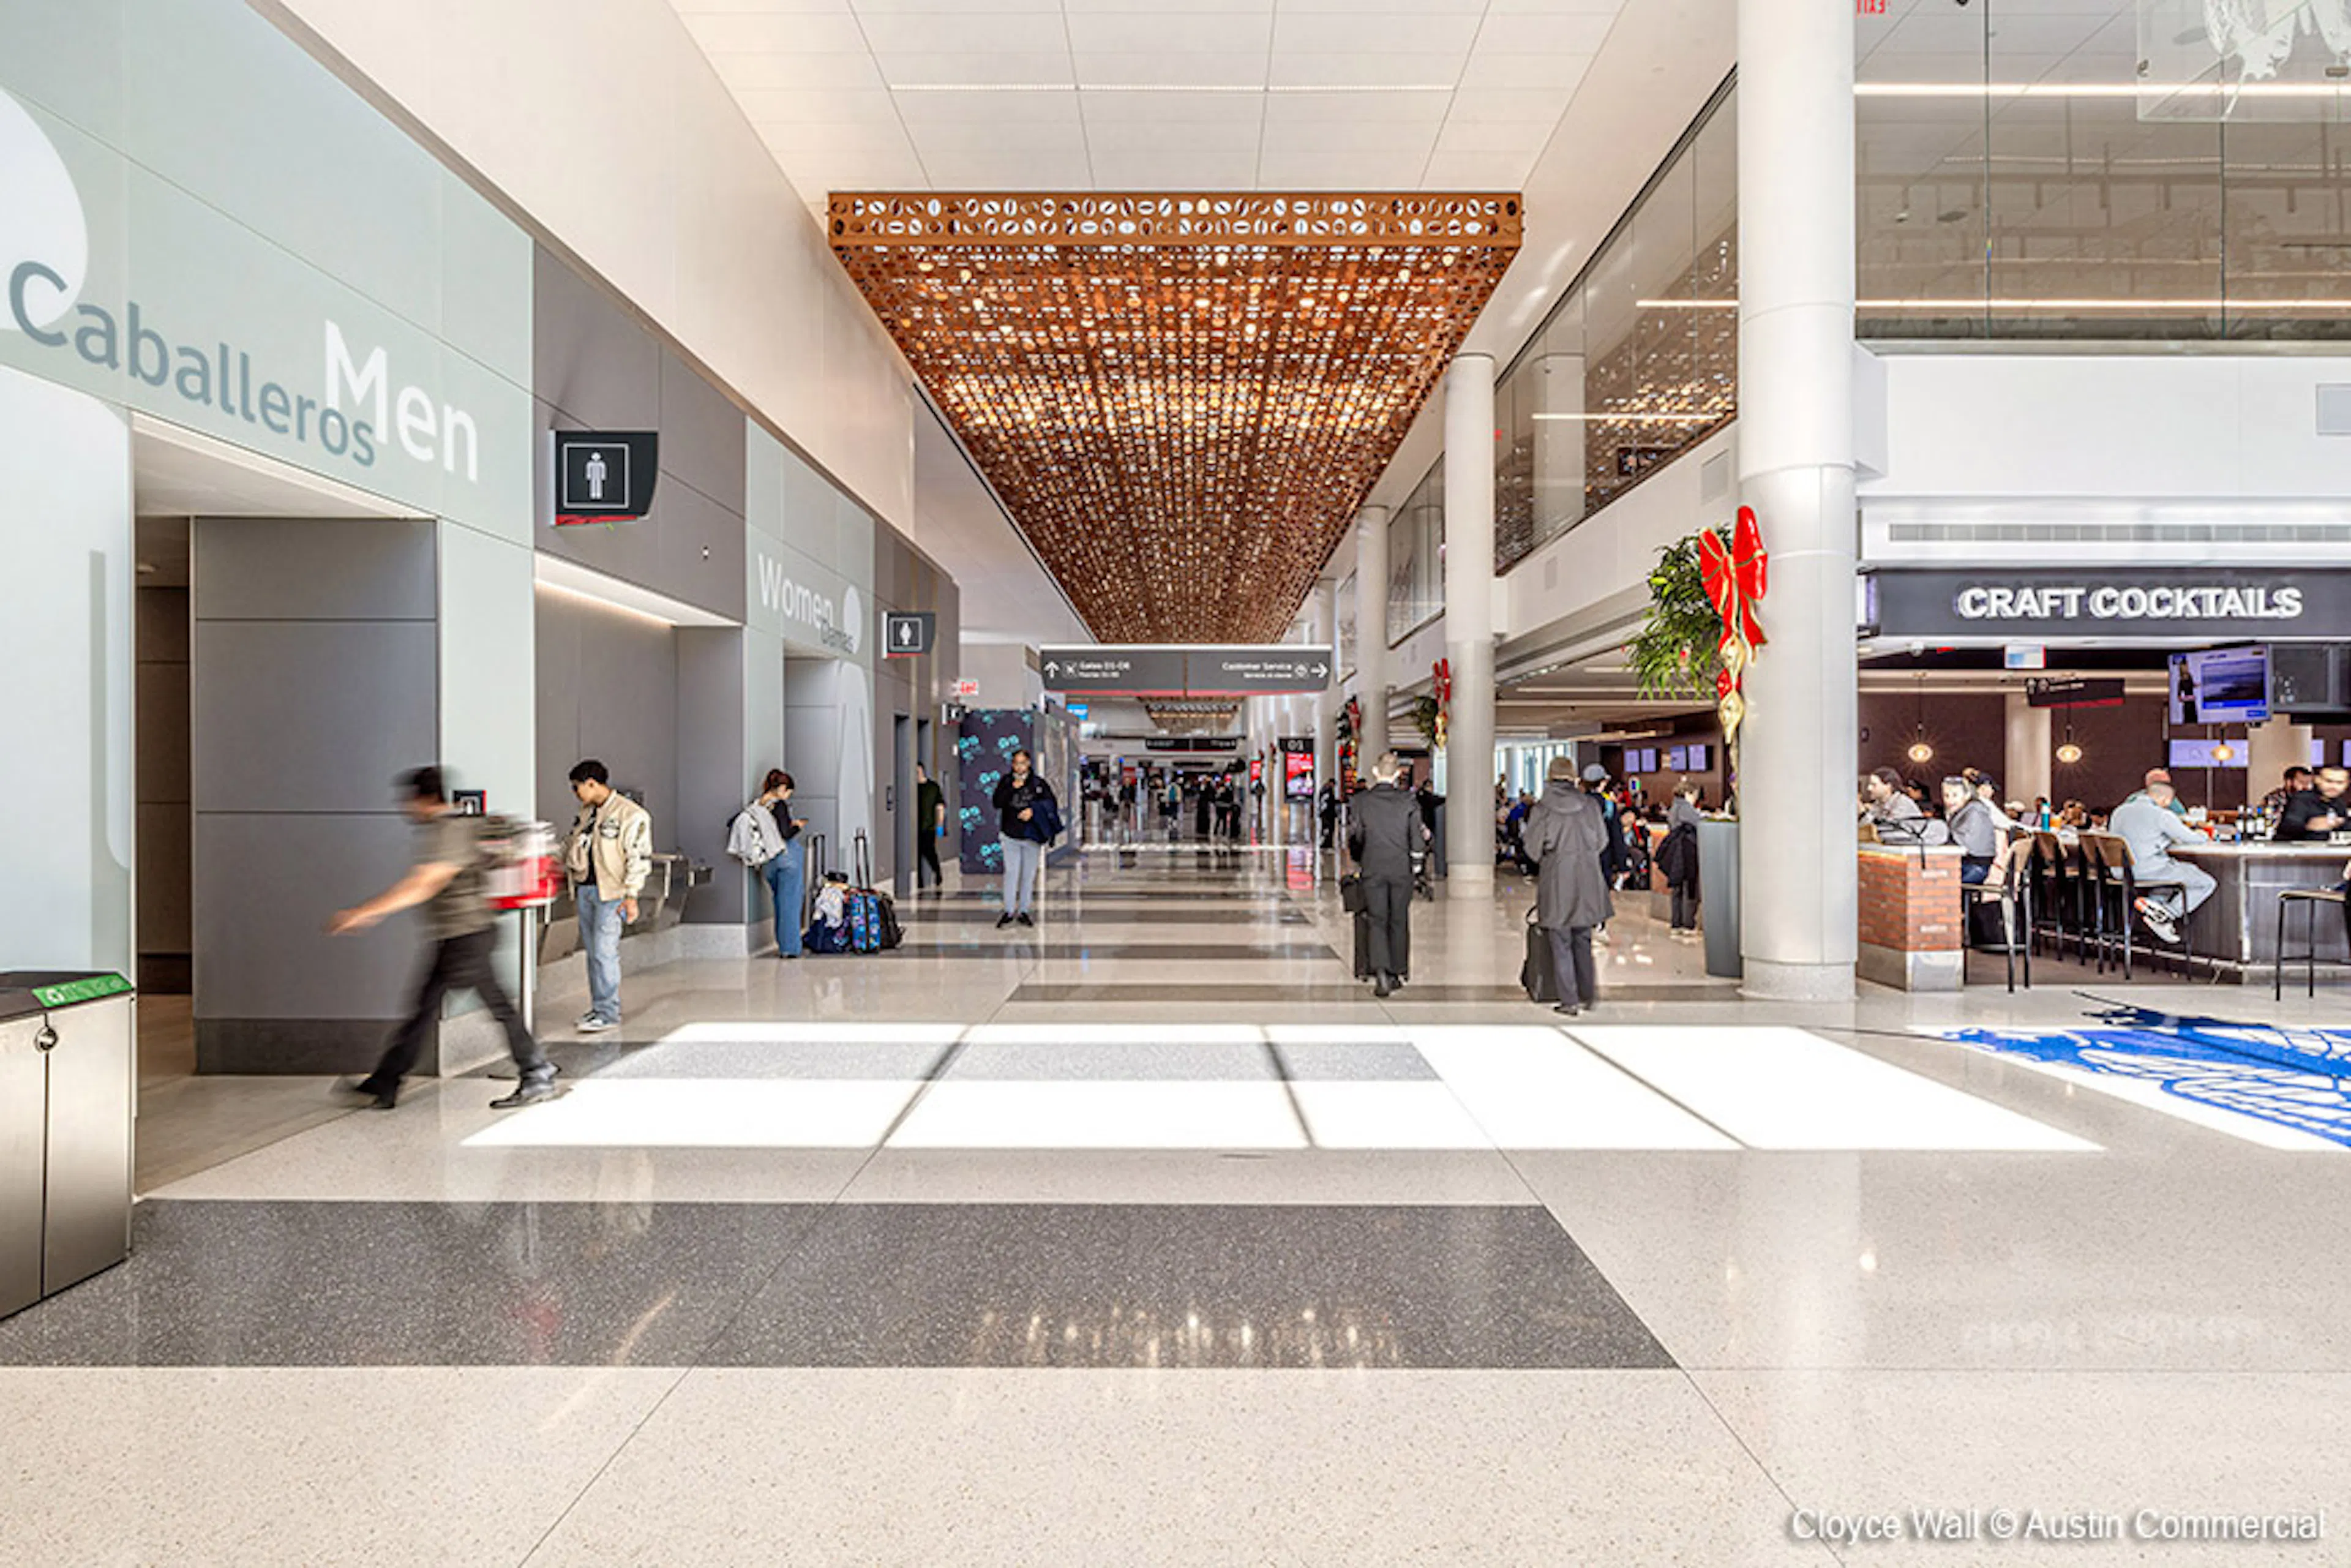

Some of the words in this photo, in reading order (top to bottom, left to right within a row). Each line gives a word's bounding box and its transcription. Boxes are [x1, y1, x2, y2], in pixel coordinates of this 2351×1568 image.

[9, 261, 375, 467] Caballeros
[325, 318, 478, 484] Men
[758, 552, 833, 630] Women
[1959, 587, 2086, 618] CRAFT
[2088, 587, 2303, 618] COCKTAILS
[1221, 661, 1261, 671] Customer
[1262, 661, 1292, 671] Service
